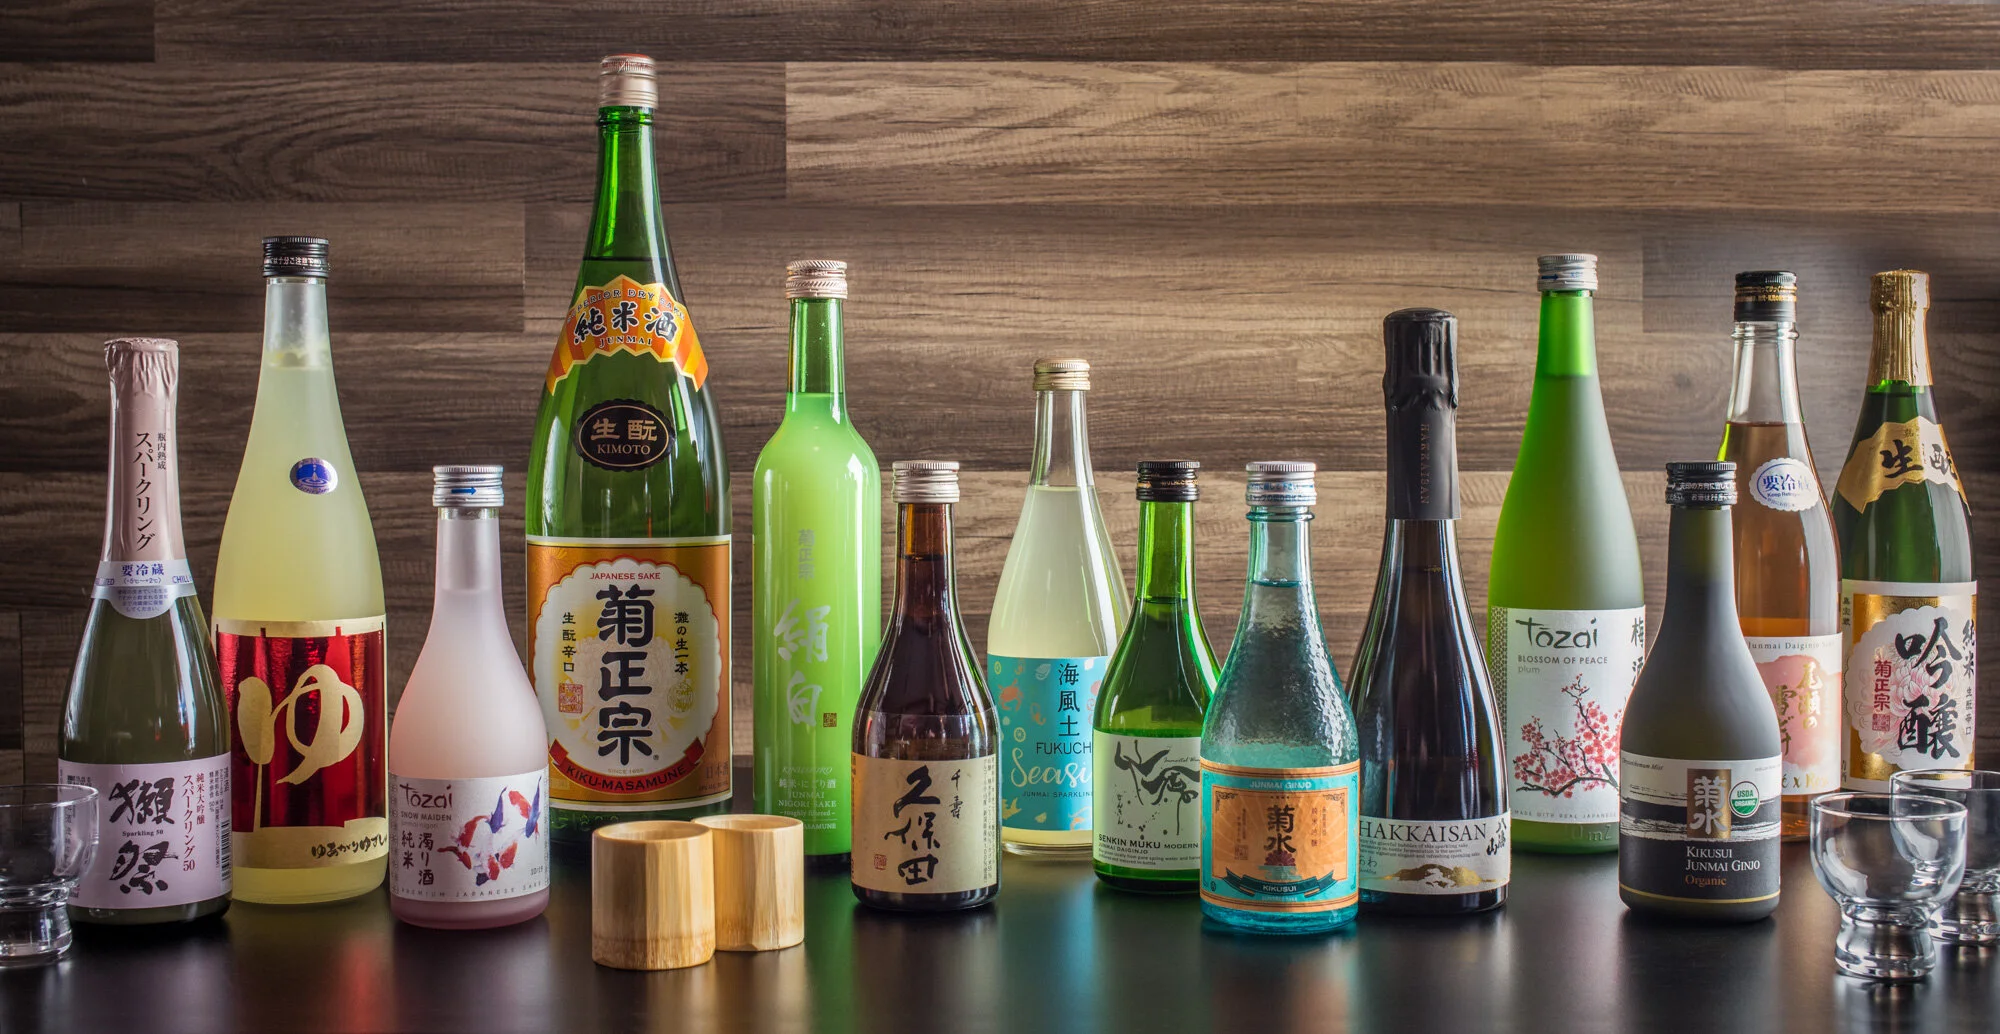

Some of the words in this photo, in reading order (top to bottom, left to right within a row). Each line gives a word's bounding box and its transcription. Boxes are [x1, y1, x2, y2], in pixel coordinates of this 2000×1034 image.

[627, 288, 655, 302] DRY
[573, 300, 679, 345] 純米酒
[599, 335, 653, 349] JUNMAI
[590, 417, 658, 443] 生酛
[597, 444, 651, 456] KIMOTO
[1420, 423, 1430, 505] HAKKAISAN
[132, 431, 156, 552] スパークリング
[797, 528, 815, 582] 菊正宗
[122, 563, 165, 577] 要冷蔵
[589, 572, 635, 581] JAPANESE
[637, 572, 661, 580] SAKE
[561, 611, 577, 673] 生酛辛口
[674, 611, 690, 676] 灘の生一本
[1748, 641, 1781, 649] Junmai
[1517, 655, 1560, 665] BLOSSOM
[1563, 656, 1576, 665] OF
[1579, 656, 1609, 665] PEACE
[595, 583, 656, 766] 菊正宗
[1518, 665, 1541, 675] plum
[1873, 659, 1893, 712] 菊正宗
[1057, 662, 1081, 738] 海風土
[1036, 741, 1092, 755] FUKUCH
[1010, 747, 1091, 788] Seasi
[566, 763, 688, 792] KIKU-MASAMUNE
[1249, 781, 1284, 789] JUNMAI
[1285, 781, 1313, 790] GINJO
[196, 772, 206, 825] 純米大吟醸
[789, 791, 825, 799] JUNMAI
[1736, 789, 1755, 798] USDA
[778, 800, 810, 808] NIGORI
[1690, 775, 1728, 835] 菊水
[1734, 799, 1756, 807] ORGANIC
[400, 811, 420, 820] SNOW
[421, 811, 453, 822] MAIDEN
[1513, 809, 1533, 817] MADE
[1582, 811, 1618, 820] JAPANESE
[884, 765, 941, 886] 久保田
[1264, 804, 1297, 854] 菊水
[1360, 820, 1487, 843] HAKKAISAN
[1098, 833, 1127, 847] SENKIN
[1129, 839, 1161, 849] MUKU
[401, 830, 416, 869] 純米
[1117, 846, 1149, 855] DAIGINJO
[418, 832, 434, 886] 濁り酒
[1262, 884, 1297, 893] KIKUSUI
[1685, 874, 1728, 888] Organic
[455, 887, 516, 897] JAPANESE
